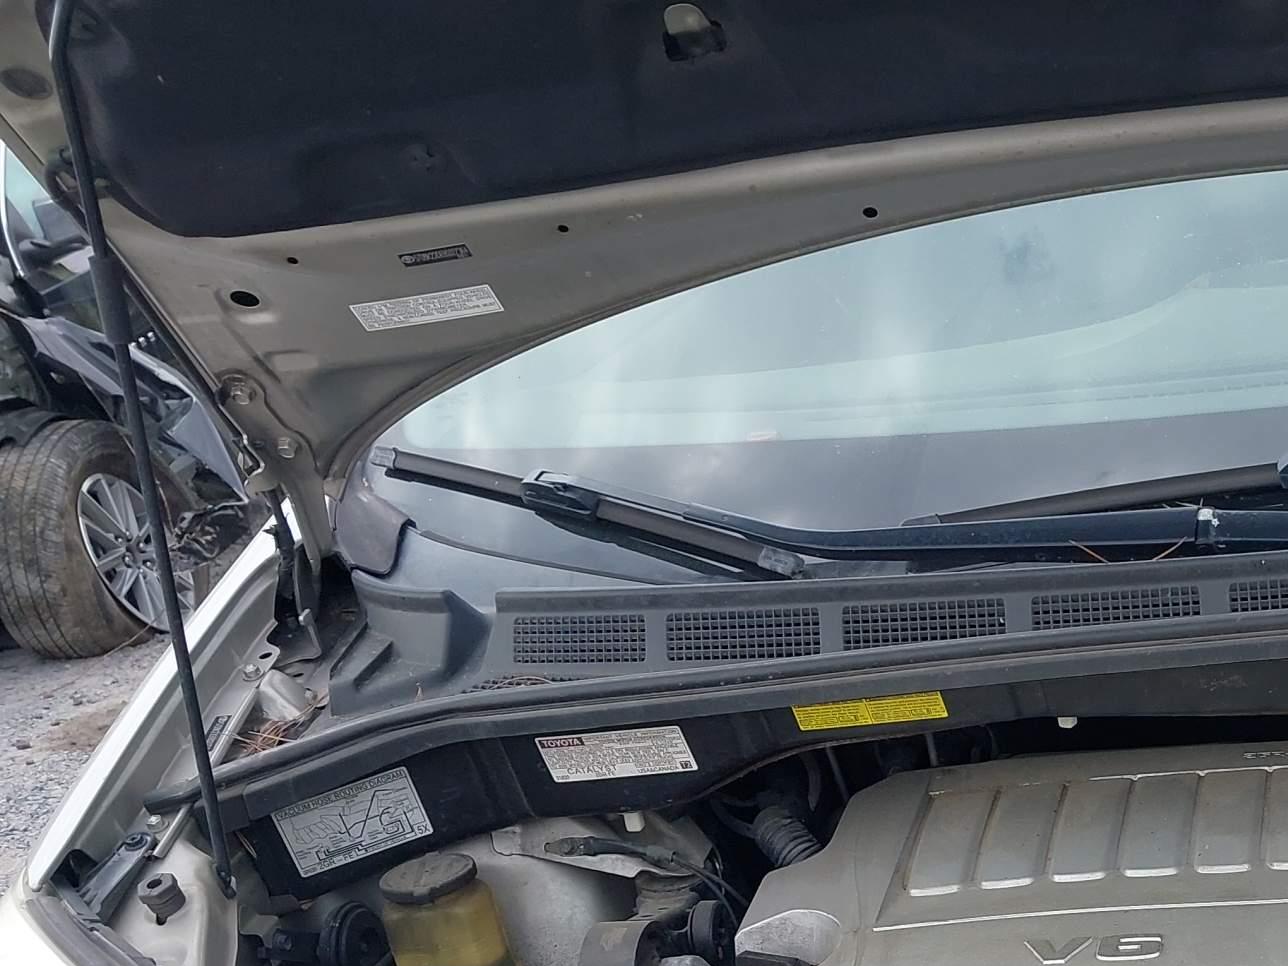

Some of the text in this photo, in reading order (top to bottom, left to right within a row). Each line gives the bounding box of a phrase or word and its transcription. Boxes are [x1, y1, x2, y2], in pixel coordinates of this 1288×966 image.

[541, 737, 582, 748] TOYOTA
[567, 764, 616, 775] CATALYST
[1023, 932, 1165, 965] V6
